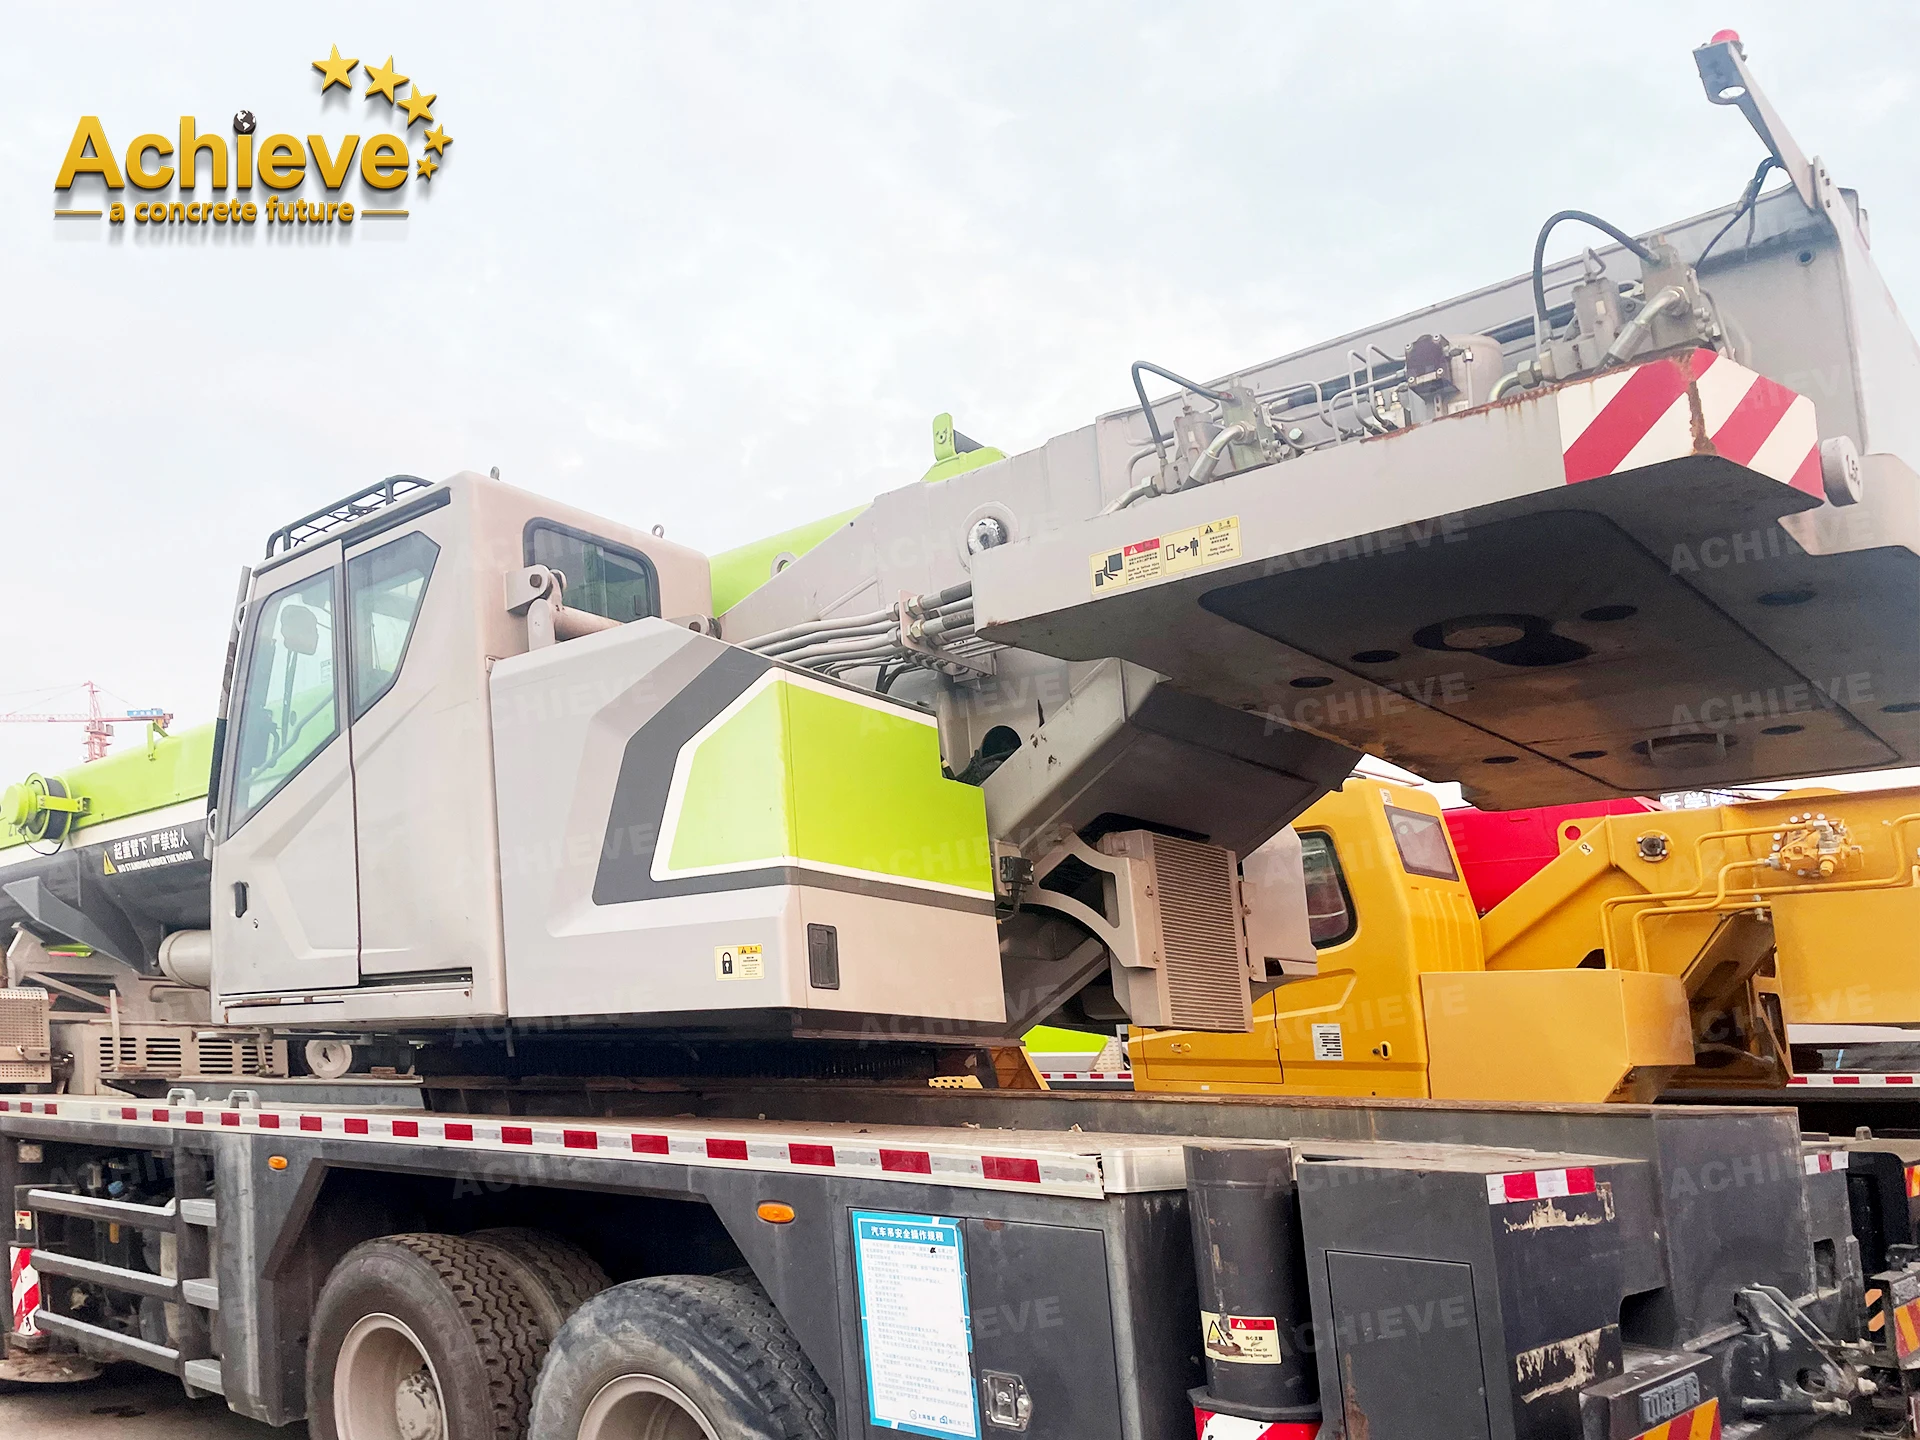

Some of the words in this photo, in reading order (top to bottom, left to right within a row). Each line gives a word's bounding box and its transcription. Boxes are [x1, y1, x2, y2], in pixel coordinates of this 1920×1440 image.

[113, 837, 148, 860] 起重臂下
[150, 827, 189, 852] 严禁站人
[870, 1226, 944, 1242] 汽车吊安全操作规程
